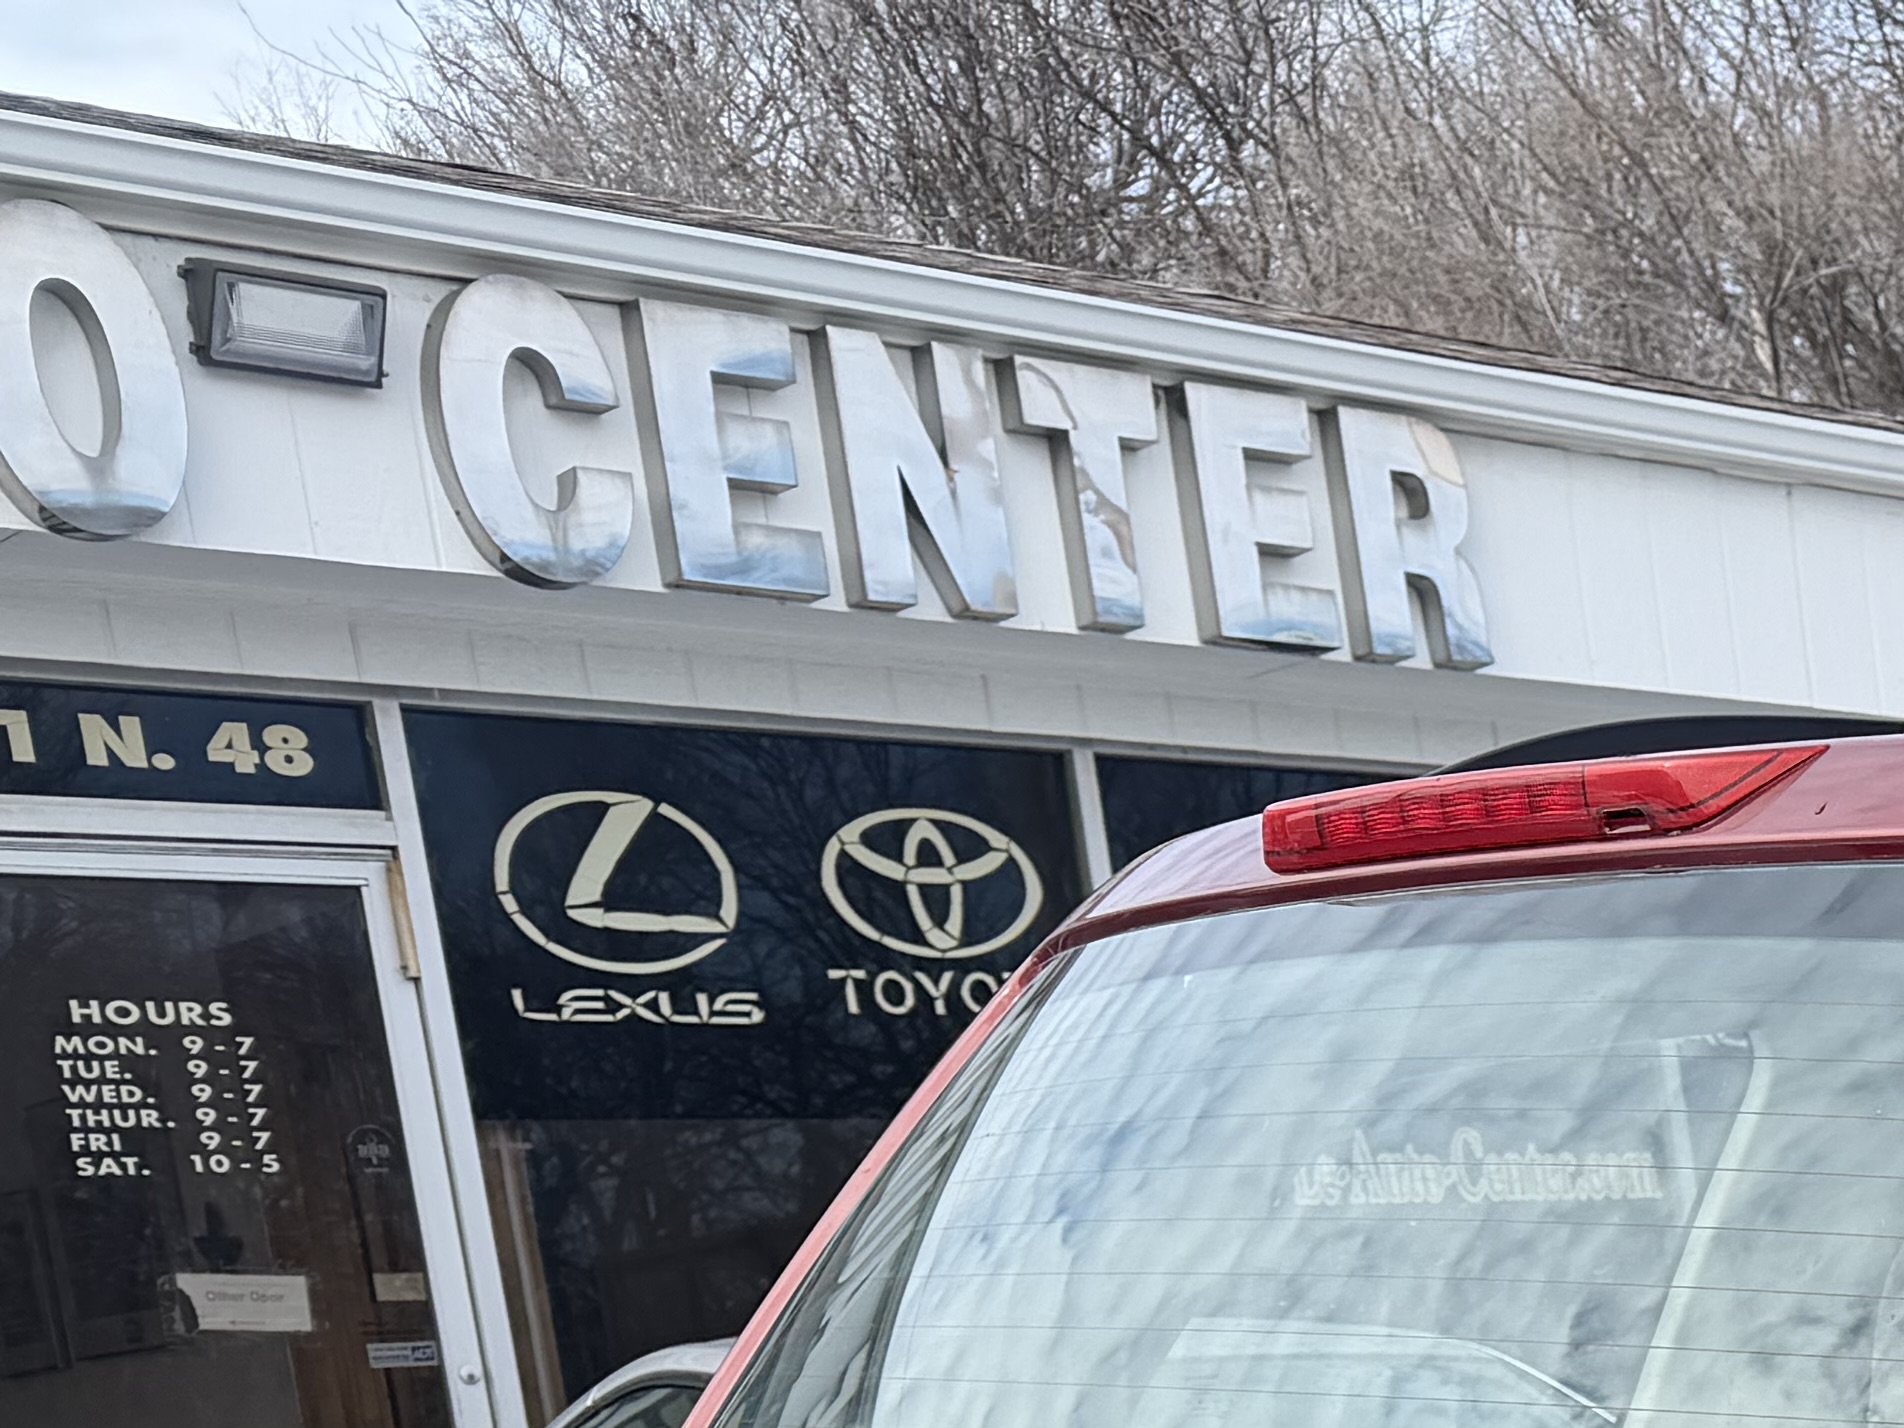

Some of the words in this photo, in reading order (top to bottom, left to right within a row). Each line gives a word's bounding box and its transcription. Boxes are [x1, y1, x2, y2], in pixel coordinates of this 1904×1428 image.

[420, 273, 1494, 671] CENTER
[77, 712, 177, 771] N.
[206, 721, 315, 777] 48
[510, 987, 766, 1025] LEXUS
[827, 968, 1014, 1017] TOYO
[68, 999, 233, 1027] HOURS
[54, 1035, 158, 1056] MON.
[56, 1059, 132, 1080] TUE.
[60, 1084, 156, 1104] WED.
[65, 1108, 176, 1129] THUR.
[69, 1133, 122, 1152] FRI
[75, 1156, 151, 1177] SAT.
